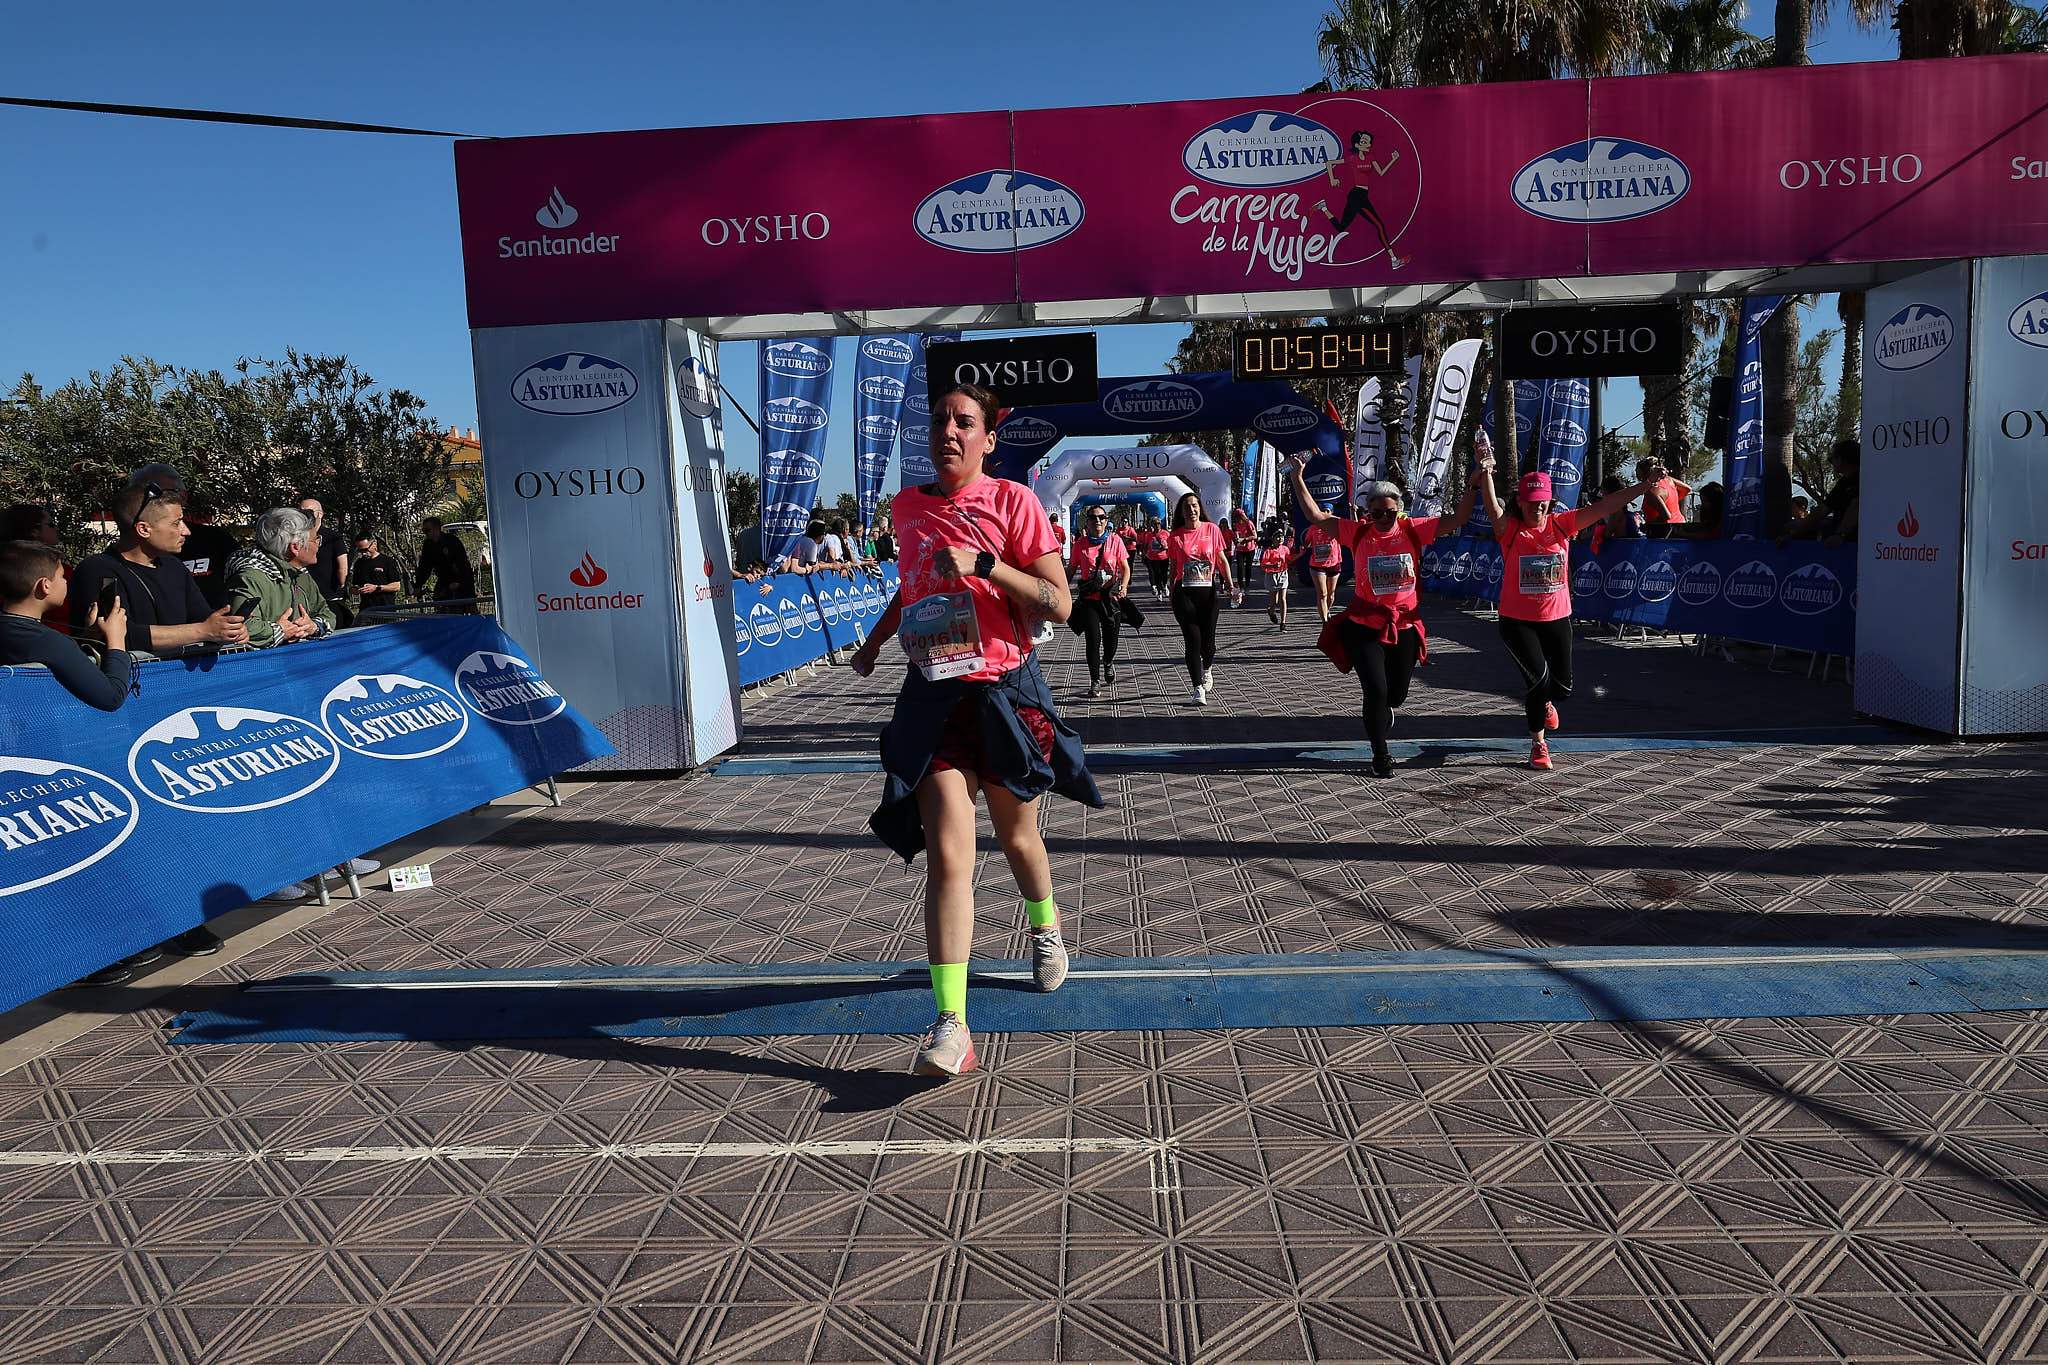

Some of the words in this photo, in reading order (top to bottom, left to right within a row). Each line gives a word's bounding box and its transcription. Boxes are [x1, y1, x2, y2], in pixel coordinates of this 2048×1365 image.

[1219, 136, 1269, 147] CENTRAL
[1274, 133, 1325, 144] LECHERA
[1195, 141, 1329, 170] ASTURIANA
[1552, 167, 1608, 177] CENTRAL
[1613, 163, 1671, 174] LECHERA
[2010, 156, 2048, 180] Sa
[1779, 154, 1923, 189] OYSHO
[1525, 171, 1677, 203] ASTURIANA
[952, 199, 1005, 209] CENTRAL
[1170, 185, 1301, 224] Carrera
[701, 212, 831, 246] OYSHO
[927, 204, 1072, 234] ASTURIANA
[498, 232, 620, 258] Santander
[1202, 225, 1226, 252] de
[1231, 224, 1249, 252] la
[1245, 216, 1350, 281] Mujer
[1245, 334, 1391, 372] 00:58:44
[1530, 327, 1657, 357] OYSHO
[1878, 329, 1948, 360] ASTURIANA
[766, 351, 827, 371] ASTURIANA
[954, 358, 1074, 386] OYSHO
[520, 378, 630, 401] ASTURIANA
[1111, 395, 1196, 413] ASTURIANA
[1260, 416, 1315, 429] ASTURIANA
[1872, 416, 1951, 451] OYSHO
[1091, 452, 1170, 471] OYSHO
[514, 467, 646, 499] OYSHO
[684, 465, 721, 494] OYSHO
[1875, 542, 1939, 563] Santander
[537, 591, 644, 612] Santander
[1726, 578, 1772, 598] ASTURIANA
[350, 700, 396, 717] CENTRAL
[396, 690, 439, 705] LECHERA
[336, 700, 463, 748] ASTURIANA
[171, 738, 240, 761] CENTRAL
[240, 723, 301, 744] LECHERA
[151, 735, 333, 801] ASTURIANA
